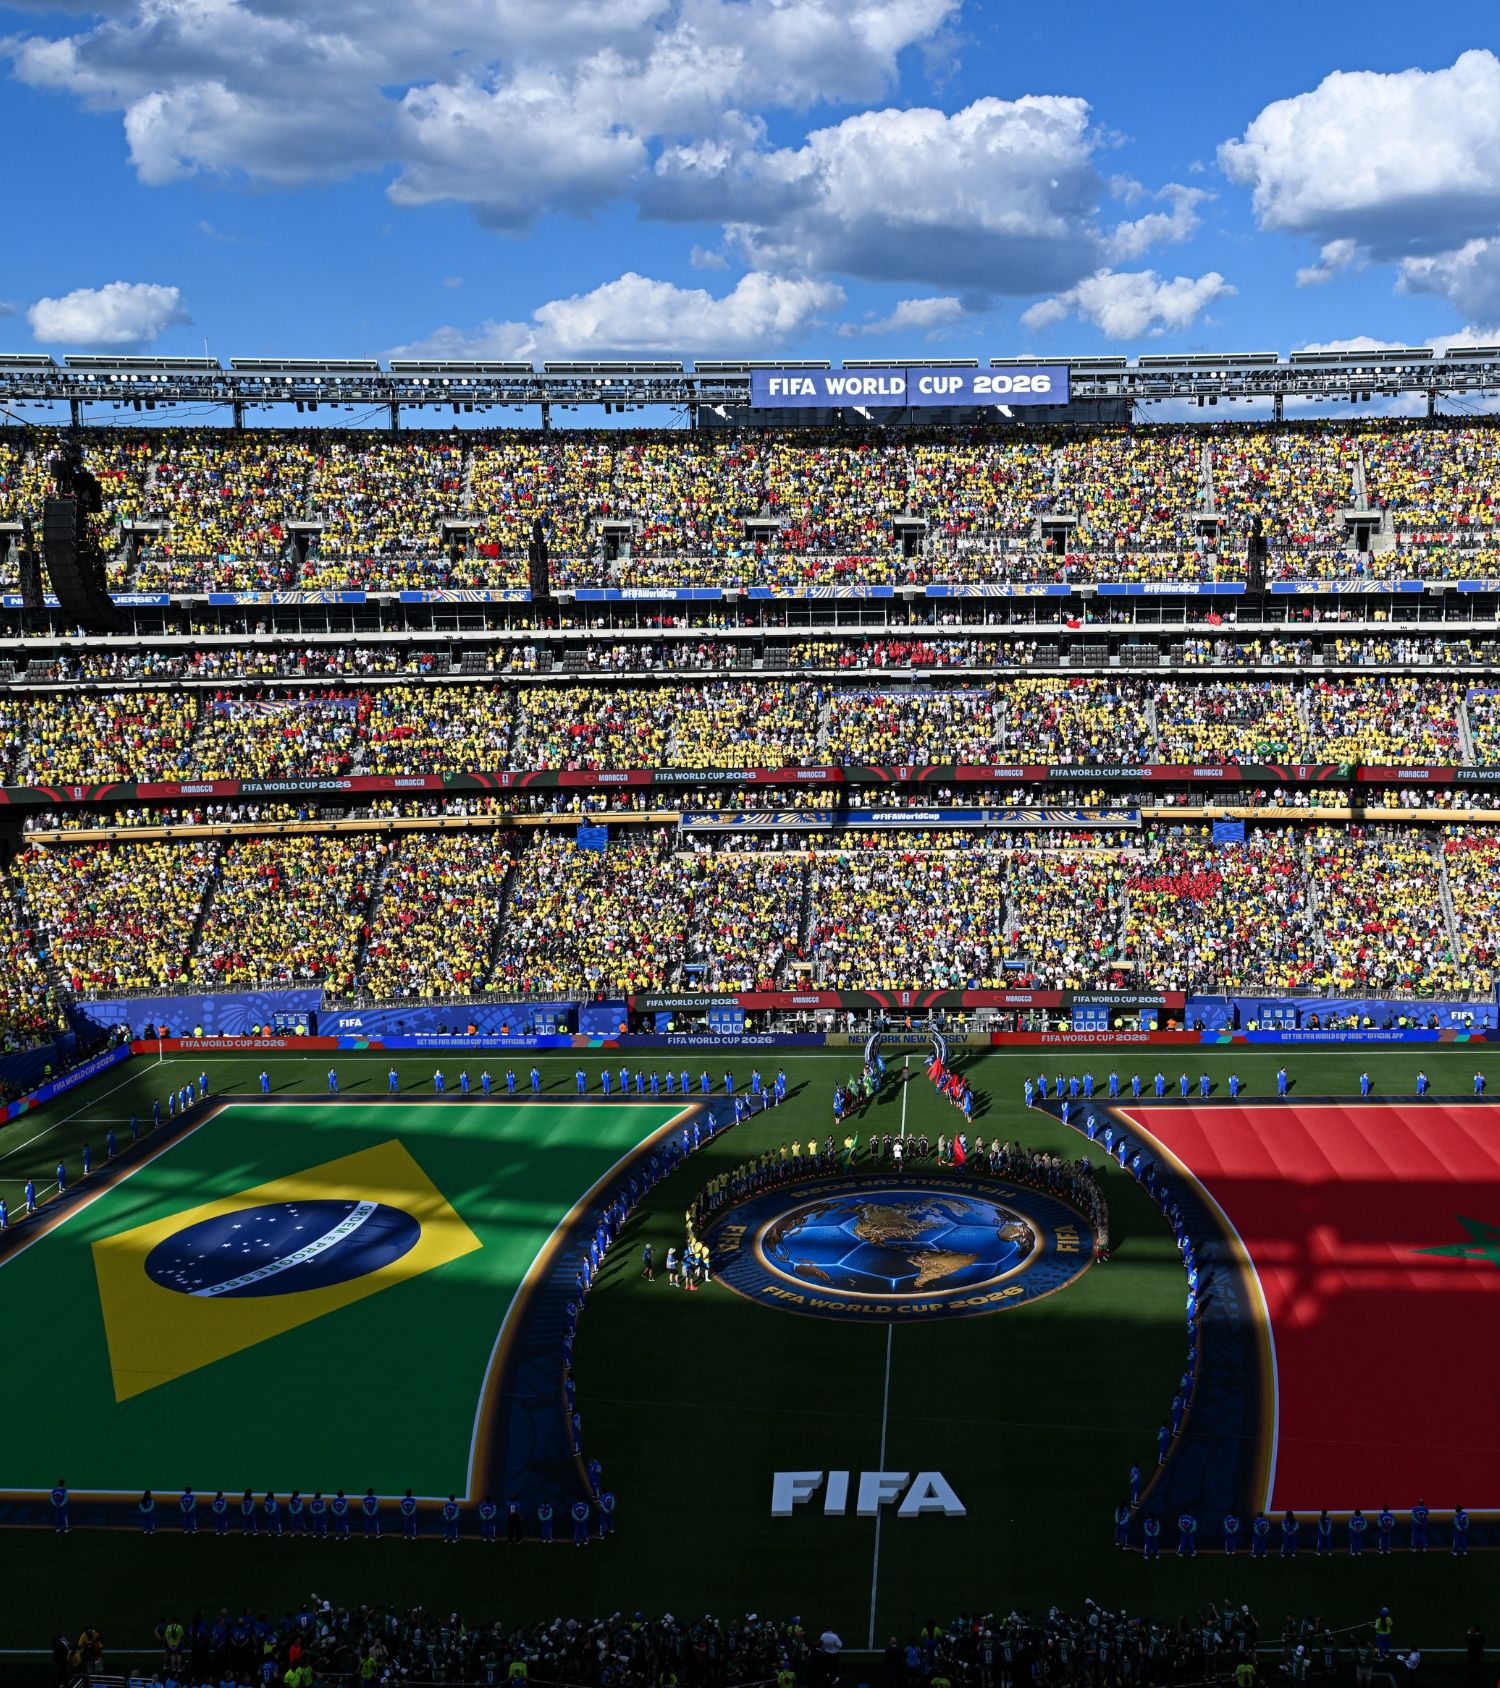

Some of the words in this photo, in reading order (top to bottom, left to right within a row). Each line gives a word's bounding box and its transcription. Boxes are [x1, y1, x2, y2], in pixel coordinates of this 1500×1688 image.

[769, 377, 816, 395] FIFA
[825, 377, 905, 395] WORLD
[918, 376, 963, 394] CUP
[973, 375, 1051, 394] 2026
[1144, 584, 1199, 594] #FIFAWorldCup
[621, 589, 677, 599] #FIFAWorldCup
[655, 773, 673, 781] FIFA
[675, 773, 705, 781] WORLD
[707, 772, 725, 780] CUP
[726, 771, 756, 779] 2026
[797, 770, 826, 779] MOROCCO
[994, 768, 1023, 777] MOROCCO
[1050, 769, 1068, 777] FIFA
[1070, 769, 1101, 777] WORLD
[1103, 769, 1121, 777] CUP
[1193, 768, 1223, 777] MOROCCO
[1398, 770, 1429, 778] MOROCCO
[598, 773, 628, 782] MOROCCO
[242, 783, 262, 791] FIFA
[263, 782, 297, 791] WORLD
[298, 782, 317, 790] CUP
[394, 778, 425, 787] MOROCCO
[181, 784, 213, 794] MOROCCO
[666, 998, 695, 1006] WORLD
[711, 997, 739, 1005] 2026
[792, 995, 819, 1003] MOROCCO
[1005, 995, 1032, 1003] MOROCCO
[1073, 995, 1090, 1003] FIFA
[1092, 995, 1121, 1003] WORLD
[1122, 995, 1137, 1003] CUP
[1138, 995, 1166, 1003] 2026
[1451, 1012, 1474, 1020] FIFA
[339, 1018, 362, 1028] FIFA
[903, 1035, 926, 1044] NEW
[1041, 1034, 1060, 1042] FIFA
[1063, 1034, 1095, 1042] WORLD
[1096, 1034, 1114, 1042] CUP
[53, 1080, 65, 1093] FIFA
[65, 1070, 85, 1086] WORLD
[85, 1064, 96, 1075] CUP
[335, 1205, 373, 1234] ORDEM
[718, 1225, 748, 1252] FIFA
[1054, 1224, 1079, 1252] FIFA
[209, 1242, 328, 1294] PROGRESSO
[761, 1284, 805, 1305] FIFA
[809, 1298, 893, 1313] WORLD
[896, 1302, 944, 1313] CUP
[948, 1284, 1024, 1309] 2026
[771, 1470, 967, 1518] FIFA
